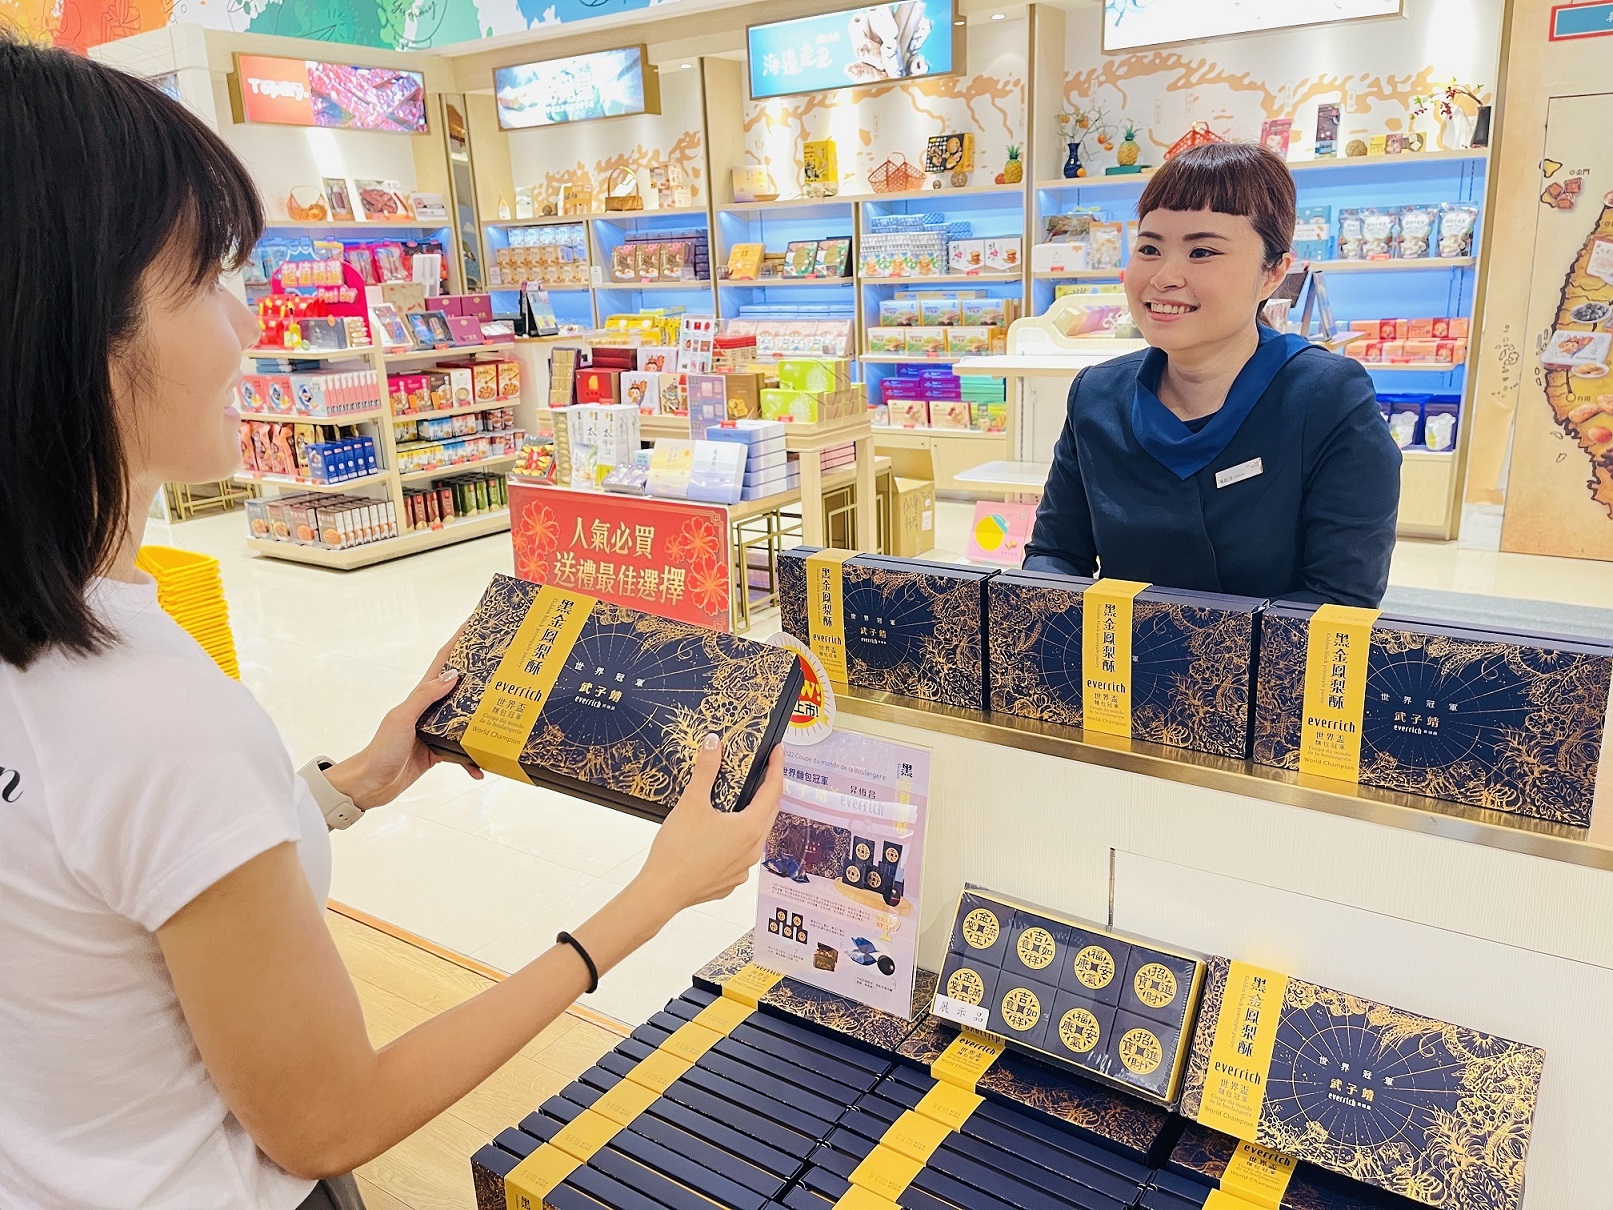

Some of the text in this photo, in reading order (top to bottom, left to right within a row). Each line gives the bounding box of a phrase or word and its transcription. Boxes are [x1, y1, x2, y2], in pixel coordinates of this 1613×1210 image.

[568, 516, 655, 560] 人氣必買
[553, 551, 687, 606] 送禮最佳選擇
[821, 567, 833, 627] 黑金鳳梨酥
[523, 599, 575, 676] 黑金鳳梨酥
[813, 634, 842, 645] everrich
[1102, 603, 1117, 673] 黑金鳳梨酥
[574, 661, 646, 687] 世界冠軍
[1328, 632, 1350, 710] 黑金鳳梨酥
[495, 681, 542, 702] everrich
[1087, 679, 1126, 693] everrich
[496, 697, 528, 713] 世界盃
[574, 696, 602, 709] everrich
[794, 700, 819, 718] 上市!
[1380, 692, 1459, 712] 世界冠軍
[472, 725, 521, 745] World Champion
[1307, 717, 1355, 733] everrich
[1393, 724, 1422, 735] everrich
[1316, 732, 1345, 743] 世界盃
[795, 751, 812, 763] Coupe
[813, 756, 821, 765] du
[821, 758, 840, 770] monde
[840, 763, 849, 772] de
[1304, 757, 1355, 770] World Champion
[783, 766, 829, 786] 世界麵包冠軍
[840, 794, 884, 817] everrich
[940, 1001, 984, 1023] 展示品
[1237, 976, 1267, 1058] 黑金鳳梨酥
[959, 1037, 996, 1056] everrich
[1215, 1061, 1261, 1085] everrich
[1318, 1055, 1395, 1086] 世界冠軍
[1220, 1078, 1250, 1096] 世界盃
[1327, 1092, 1356, 1107] everrich
[1204, 1105, 1254, 1128] World Champion
[1243, 1144, 1291, 1167] everrich
[1230, 1170, 1248, 1180] World
[1250, 1177, 1281, 1192] Champion
